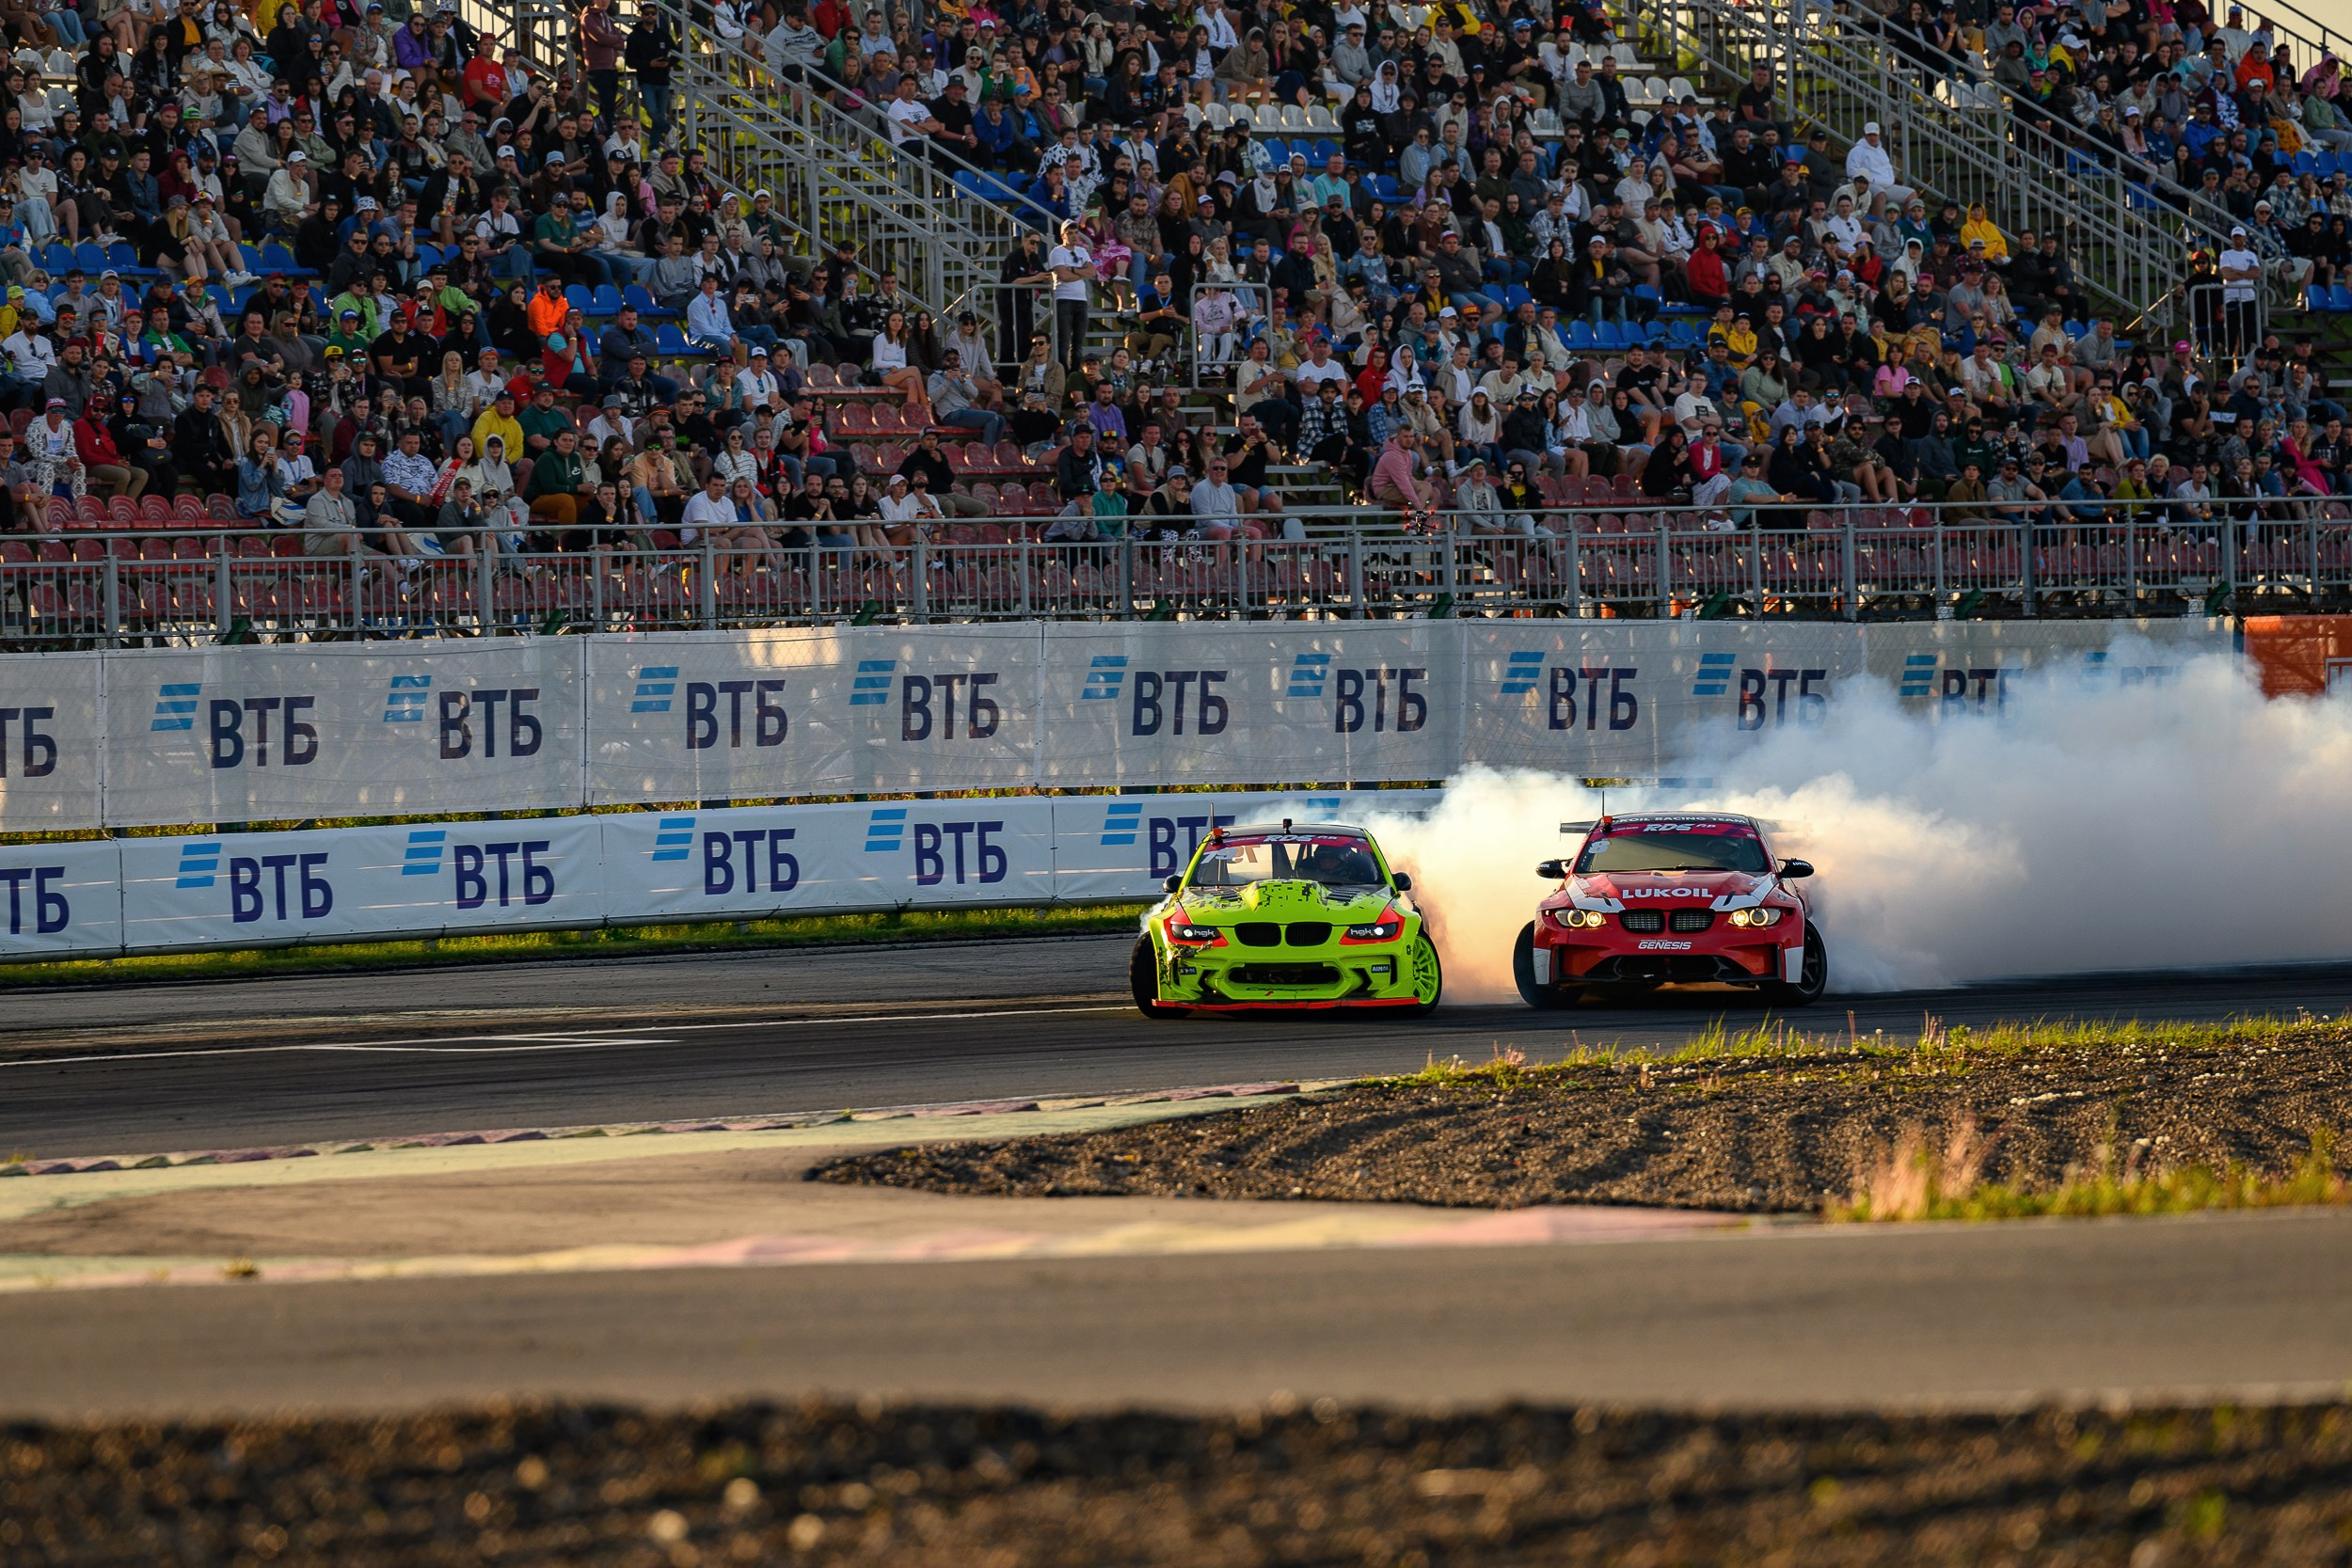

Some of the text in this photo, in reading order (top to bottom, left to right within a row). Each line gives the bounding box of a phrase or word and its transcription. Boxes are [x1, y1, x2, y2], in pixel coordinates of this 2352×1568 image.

[439, 689, 543, 759] ВТБ
[687, 680, 788, 750] ВТБ
[901, 673, 1000, 741] ВТБ
[1133, 671, 1229, 736] ВТБ
[1336, 668, 1428, 733] ВТБ
[1549, 667, 1638, 731] ВТБ
[1739, 668, 1827, 731] ВТБ
[210, 696, 319, 768] ВТБ
[914, 820, 1007, 885] ВТБ
[1149, 816, 1236, 879] ВТ
[1263, 834, 1315, 843] RDS
[1643, 823, 1695, 832] RDS
[230, 852, 333, 923] ВТБ
[454, 841, 555, 910] ВТБ
[704, 828, 800, 895] ВТБ
[1622, 887, 1714, 899] LUKOIL
[1194, 928, 1215, 937] hgk
[1350, 927, 1372, 936] hgk
[1638, 942, 1692, 950] GENESIS
